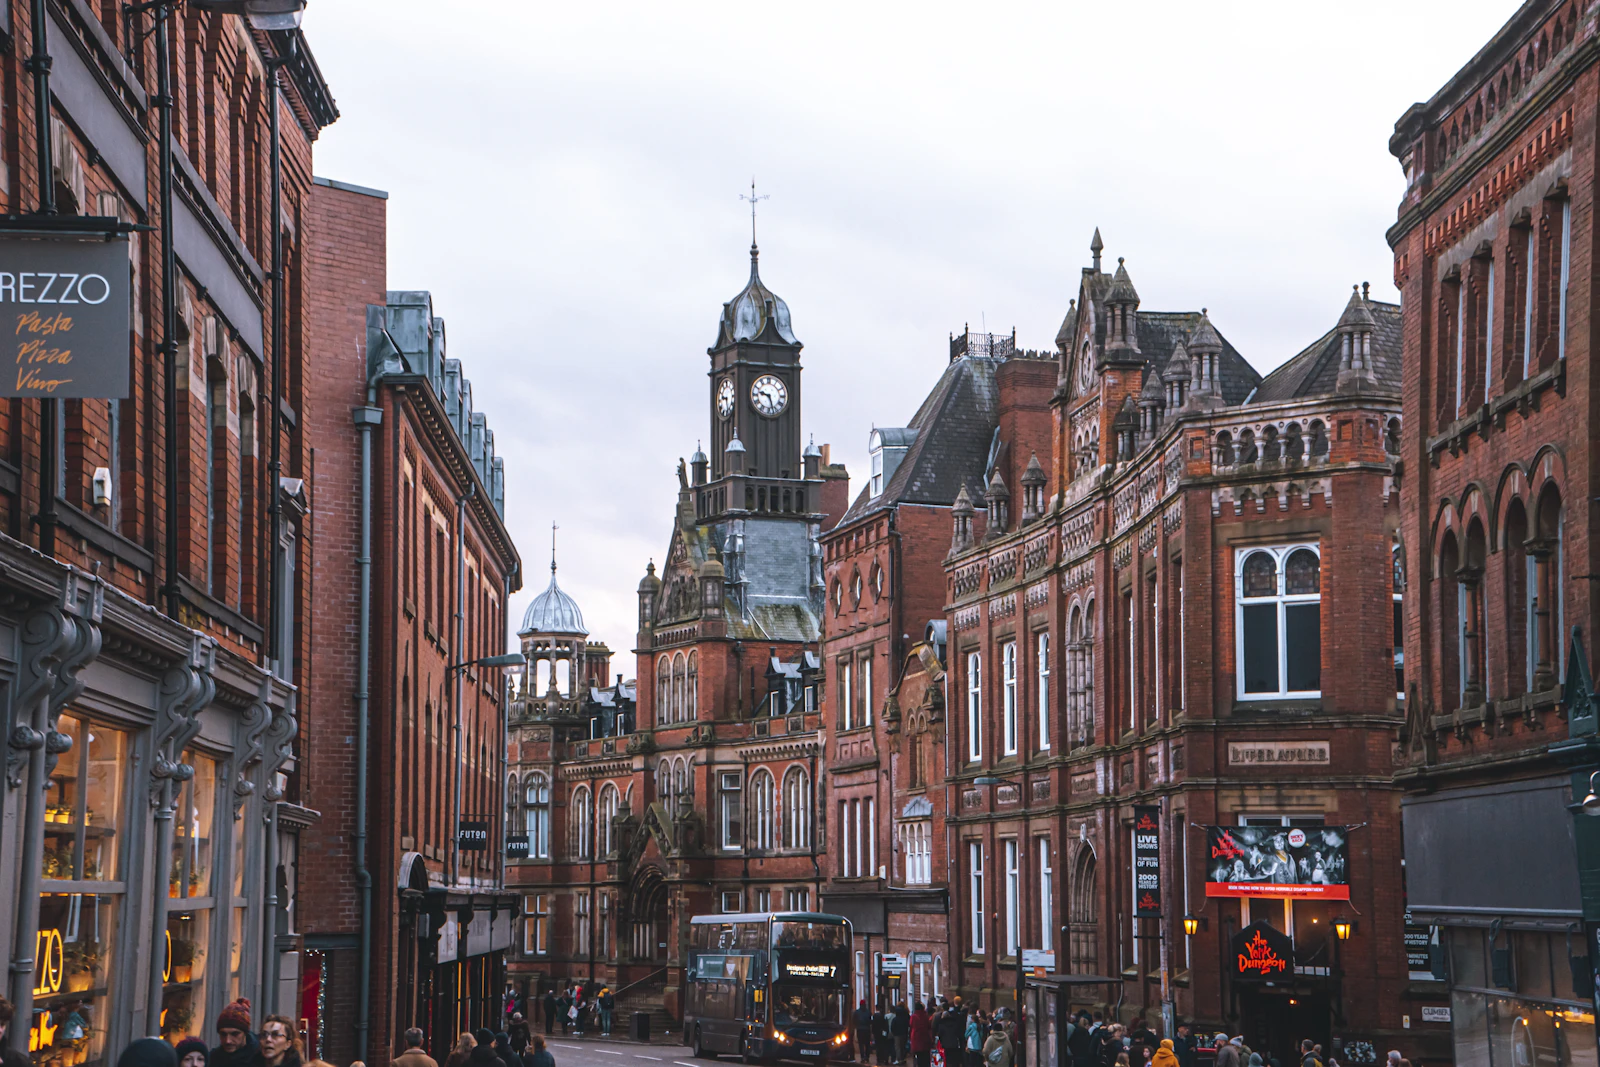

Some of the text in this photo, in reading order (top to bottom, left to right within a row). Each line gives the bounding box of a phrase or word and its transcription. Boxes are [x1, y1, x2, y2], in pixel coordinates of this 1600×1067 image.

[0, 272, 110, 305] REZZO
[15, 310, 75, 336] Pasta
[16, 339, 74, 364] Pizza
[16, 367, 73, 392] Vino
[1137, 835, 1158, 844] LIVE
[1245, 942, 1277, 960] York
[830, 966, 837, 978] 7
[1238, 954, 1286, 975] Dungeon
[1422, 1007, 1450, 1016] CUMBER
